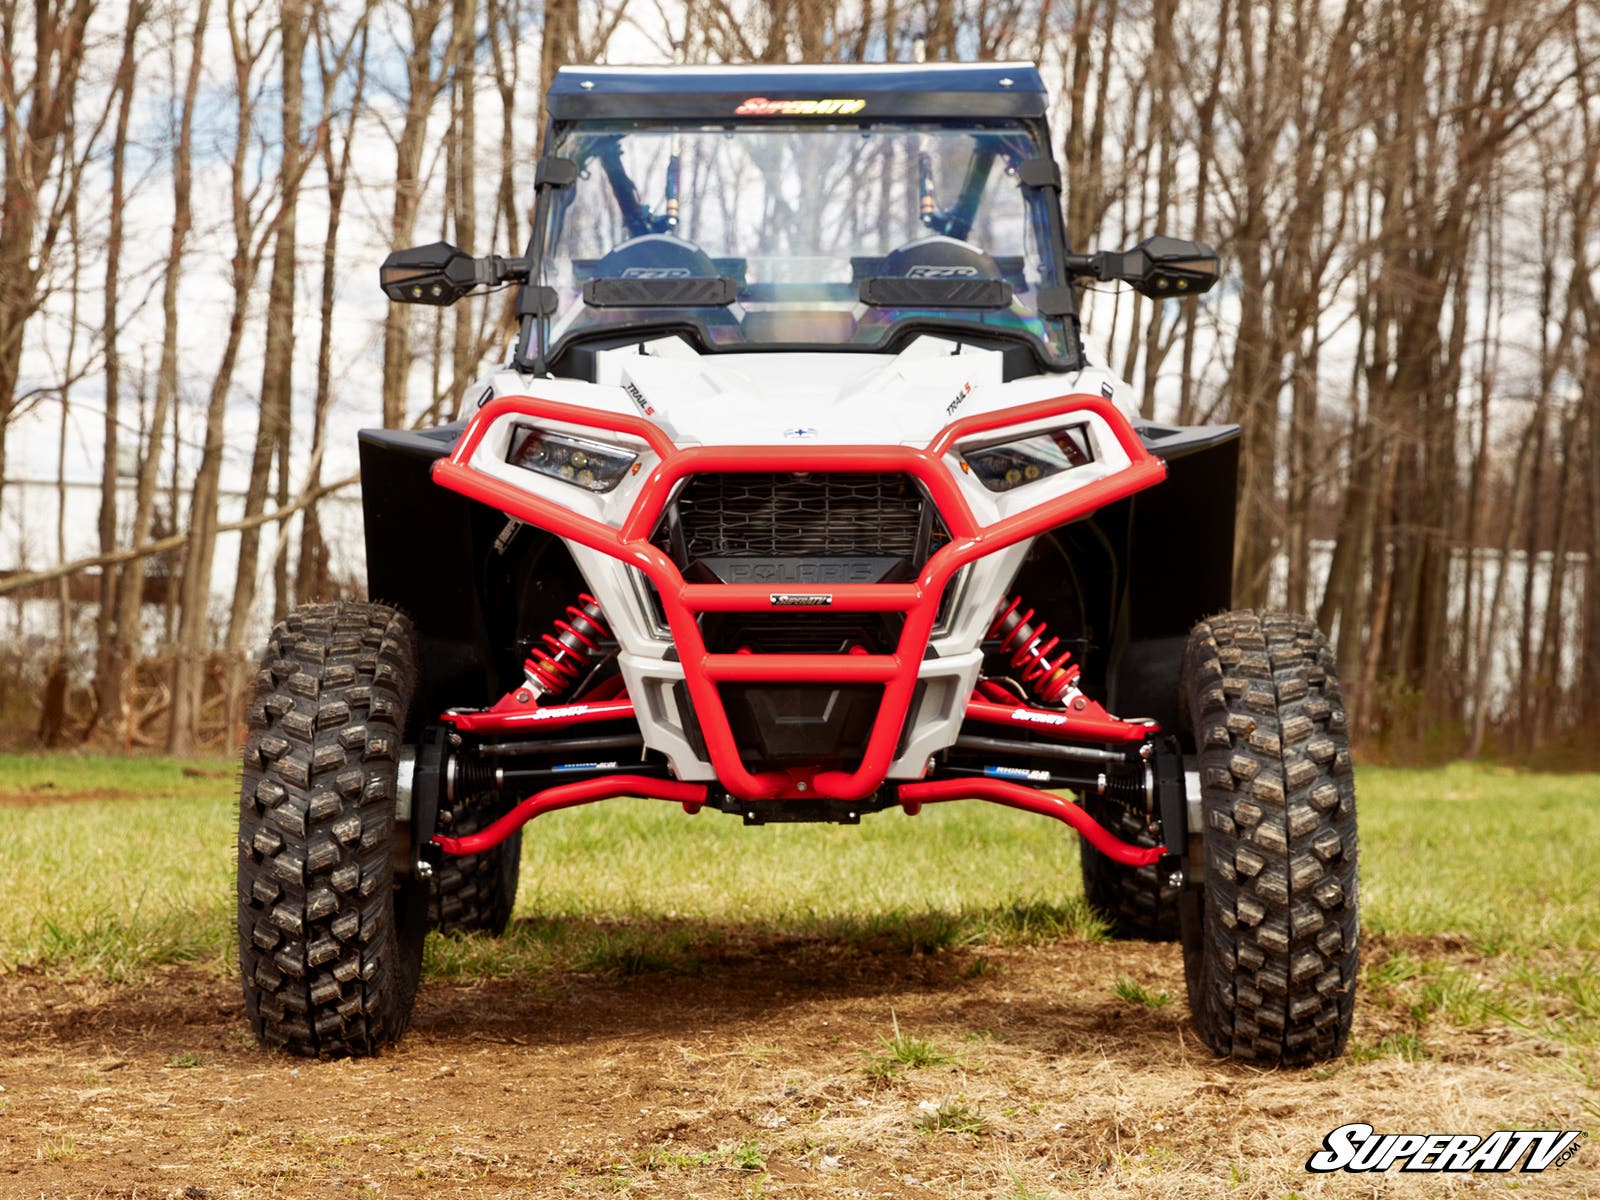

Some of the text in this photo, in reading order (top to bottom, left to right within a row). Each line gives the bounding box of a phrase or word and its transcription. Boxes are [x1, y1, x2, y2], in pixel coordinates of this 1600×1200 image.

[627, 381, 647, 409] TRAIL
[946, 390, 966, 416] TRAIL
[729, 563, 873, 584] POLARIS
